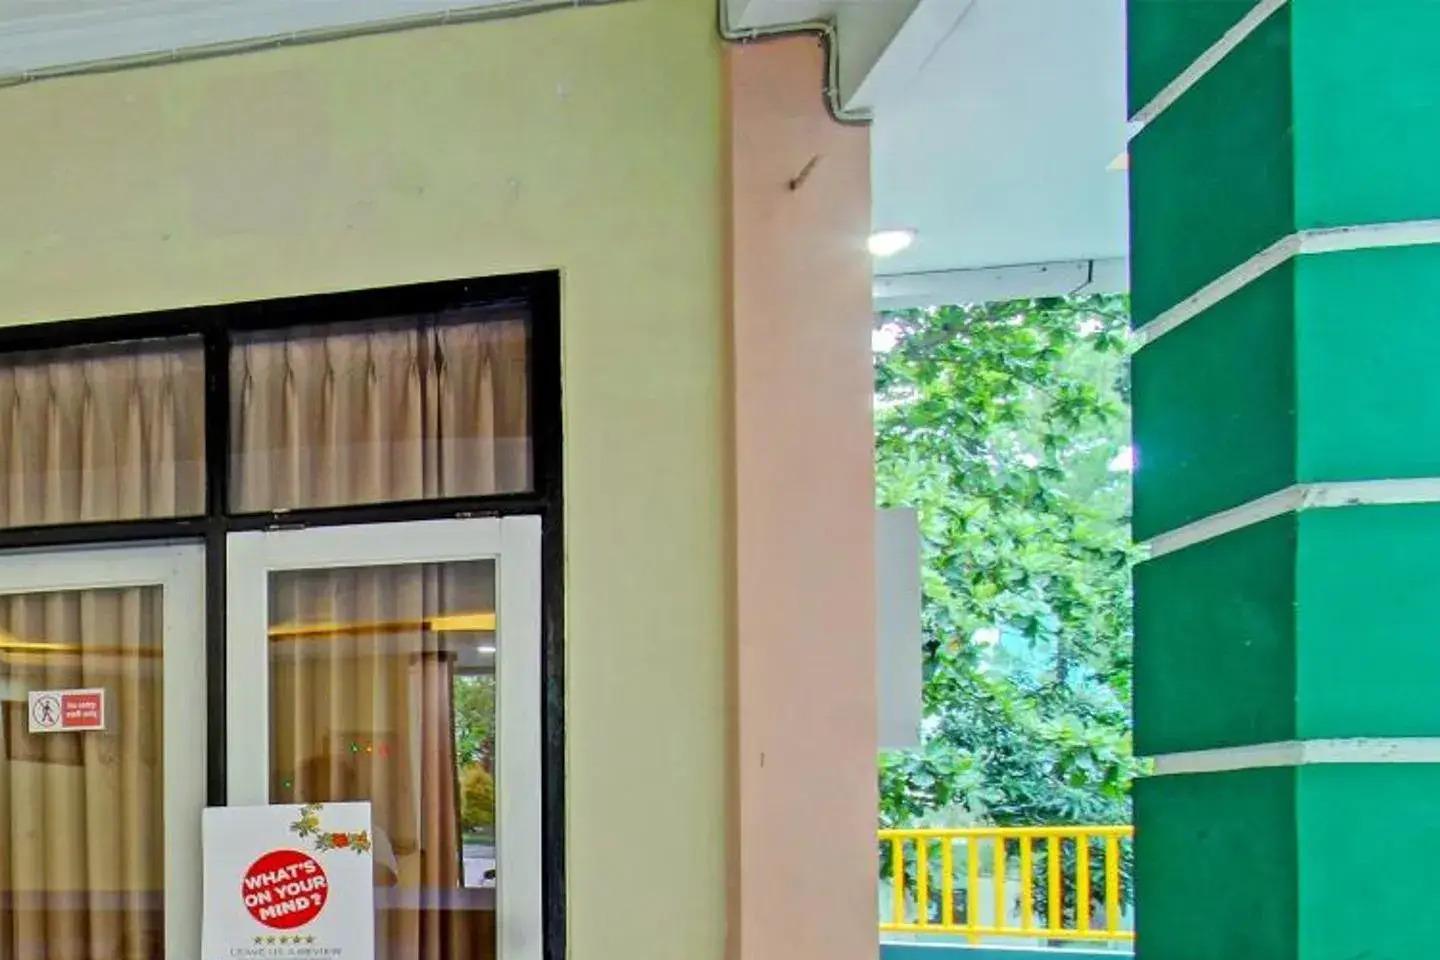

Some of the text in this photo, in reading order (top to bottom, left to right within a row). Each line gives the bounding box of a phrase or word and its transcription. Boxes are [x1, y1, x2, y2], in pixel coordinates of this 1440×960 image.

[245, 860, 316, 890] WHAT'S
[245, 875, 327, 907] ON YOUR
